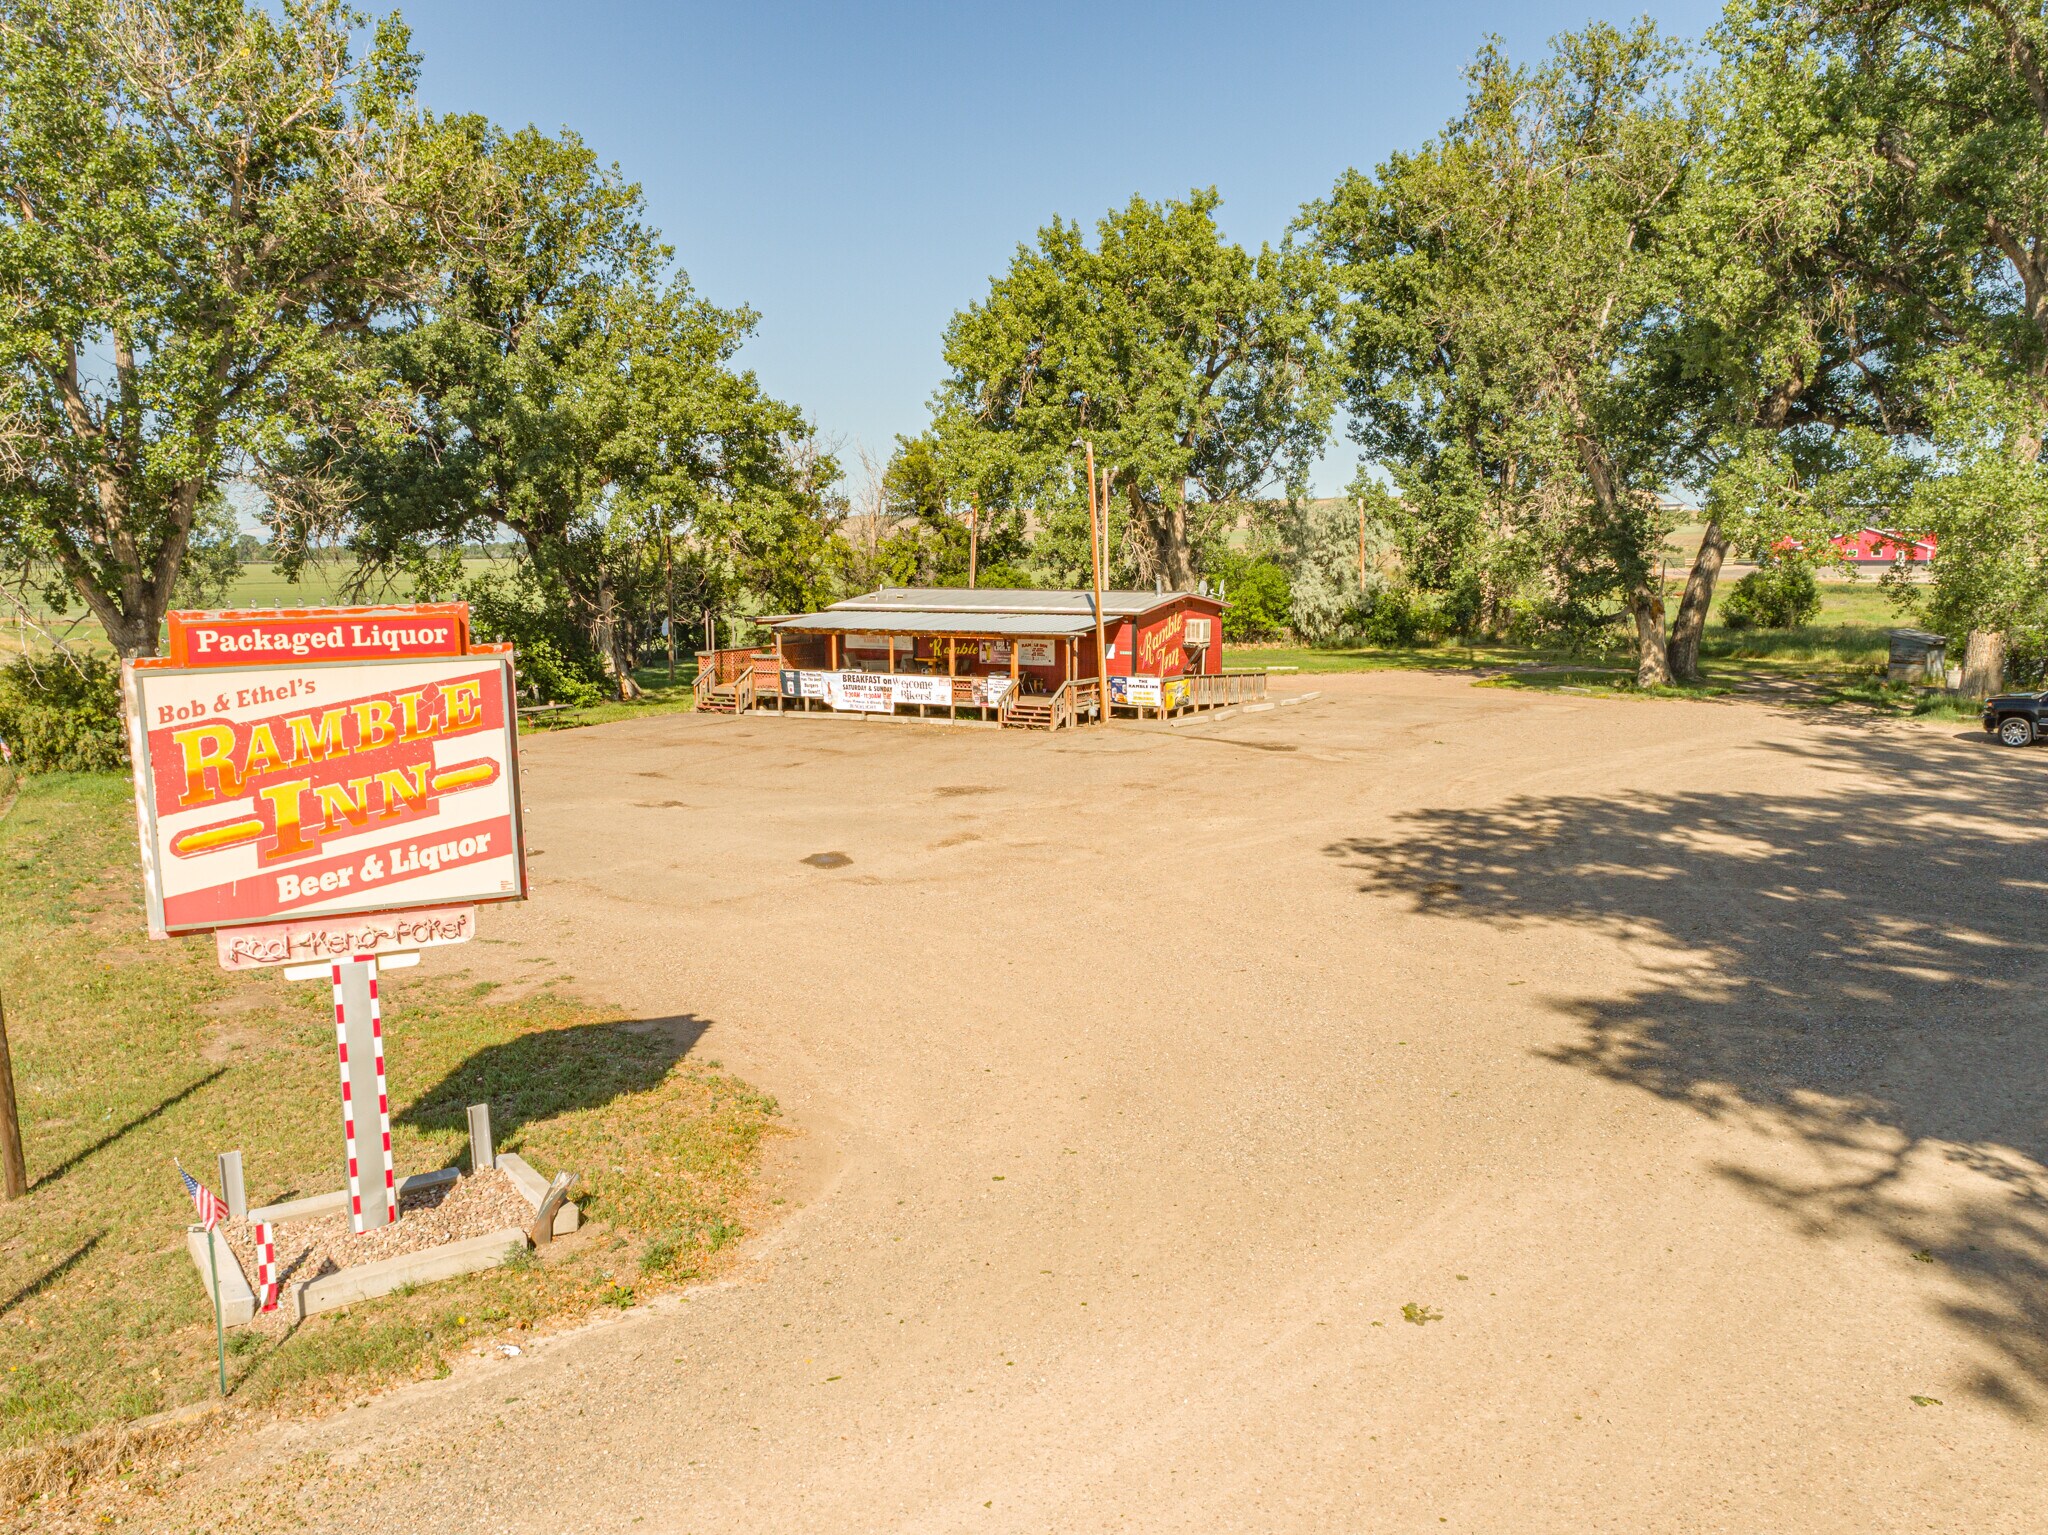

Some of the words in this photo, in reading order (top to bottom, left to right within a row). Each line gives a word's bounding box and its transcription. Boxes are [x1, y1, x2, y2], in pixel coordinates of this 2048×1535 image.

[196, 627, 345, 655] Packaged
[351, 625, 448, 651] Liquor
[1140, 612, 1183, 664] Ramble
[1157, 643, 1180, 677] Inn
[842, 674, 881, 685] BREAKFAST
[842, 684, 867, 692] SATURDAY
[873, 685, 892, 693] SUNDAY
[893, 678, 933, 690] Welcome
[901, 689, 932, 701] Bikers!
[158, 699, 206, 724] Bob
[213, 692, 230, 713] &
[236, 678, 316, 708] Ethel's
[172, 679, 482, 807] RAMBLE
[259, 761, 432, 861] INN
[276, 866, 353, 903] Beer
[360, 853, 385, 882] &
[389, 832, 492, 876] Liquor
